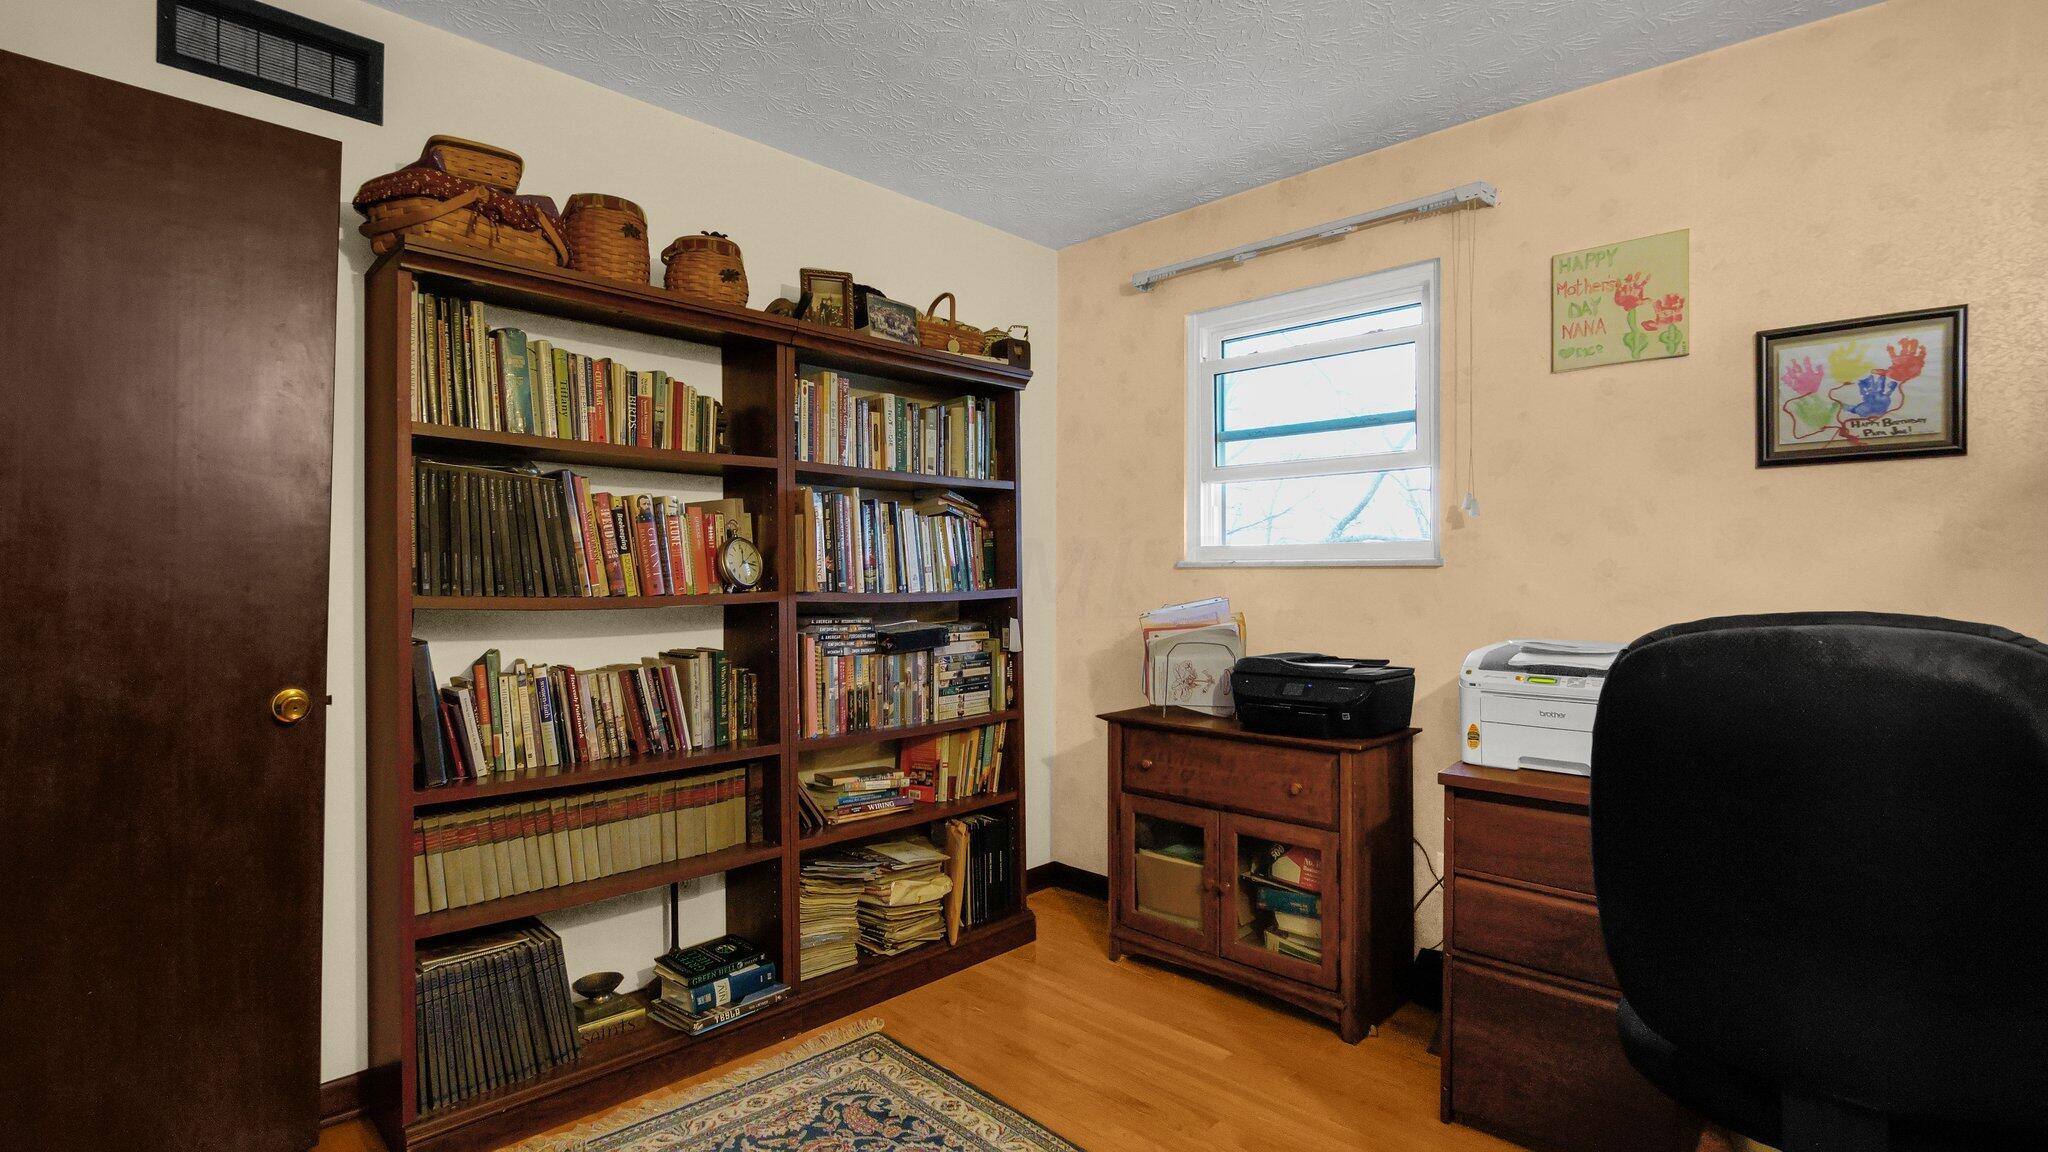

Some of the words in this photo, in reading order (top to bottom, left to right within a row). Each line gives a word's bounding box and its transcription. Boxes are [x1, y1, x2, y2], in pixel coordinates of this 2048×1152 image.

[1559, 247, 1618, 273] HAPPY
[1568, 297, 1601, 318] DAY
[1562, 318, 1606, 339] NANA
[560, 380, 569, 418] Tiffany
[628, 396, 636, 430] BIRDS
[601, 512, 613, 538] FEUD
[618, 513, 628, 550] Beekeeping
[669, 520, 680, 547] ALONE
[648, 528, 660, 576] GRANT
[574, 704, 584, 739] Patchwork
[1540, 710, 1566, 719] brother
[868, 801, 895, 810] WIRING
[692, 971, 717, 985] GREEN
